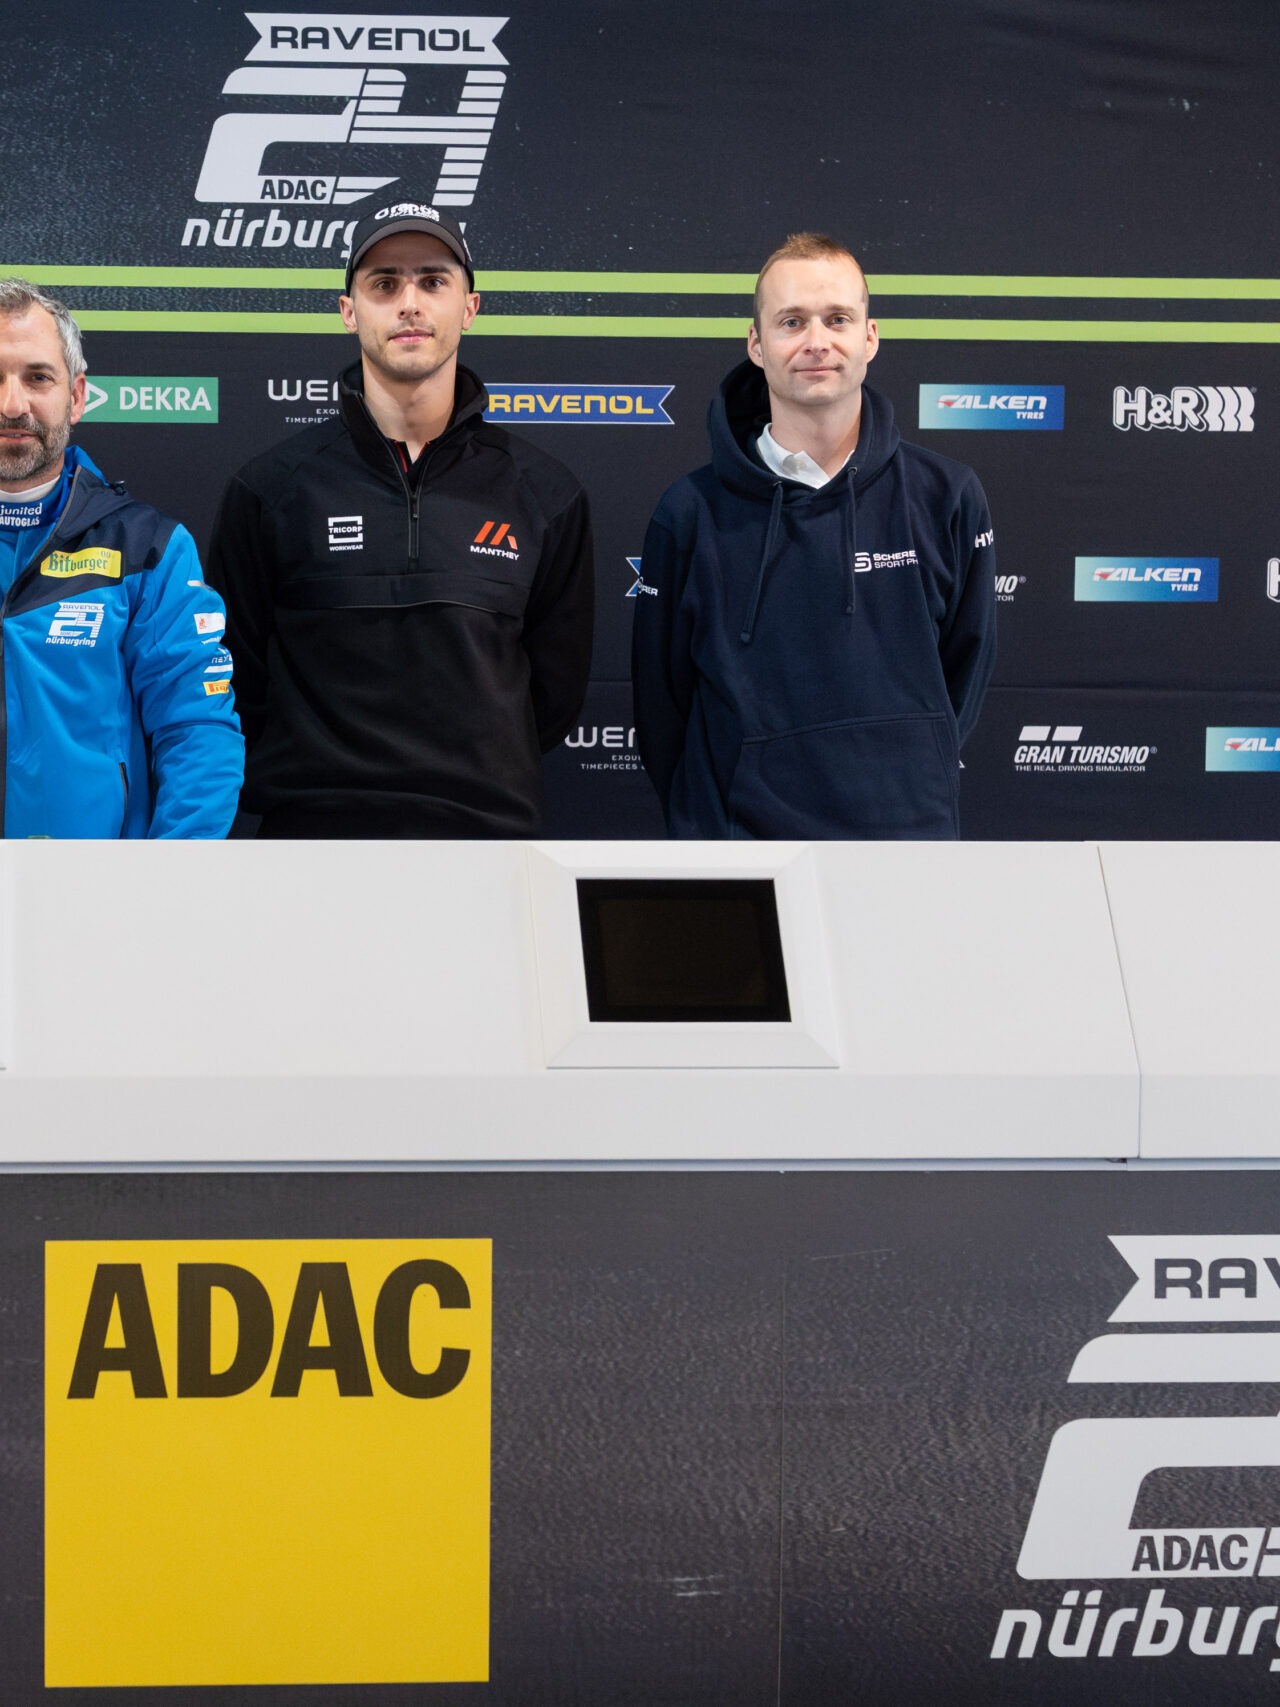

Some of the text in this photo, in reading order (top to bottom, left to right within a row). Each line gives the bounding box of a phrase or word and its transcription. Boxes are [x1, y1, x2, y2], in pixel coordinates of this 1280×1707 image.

[269, 25, 485, 52] RAVENOL
[260, 179, 327, 200] ADAC
[119, 386, 212, 411] DEKRA
[488, 394, 654, 414] RAVENOL
[937, 395, 1047, 410] FALKEN
[1016, 411, 1044, 420] TYRES
[1113, 386, 1207, 432] H&R
[0, 502, 43, 516] junited
[328, 526, 363, 534] TRICORP
[470, 545, 520, 560] MANTHEY
[48, 552, 108, 573] Bitburger
[874, 559, 904, 569] SPORT
[1093, 568, 1202, 582] FALKEN
[1171, 583, 1199, 592] TYRES
[45, 636, 97, 648] nürburgring
[1014, 745, 1150, 764] GRAN TURISMO
[66, 1258, 471, 1400] ADAC
[1131, 1533, 1249, 1572] ADAC
